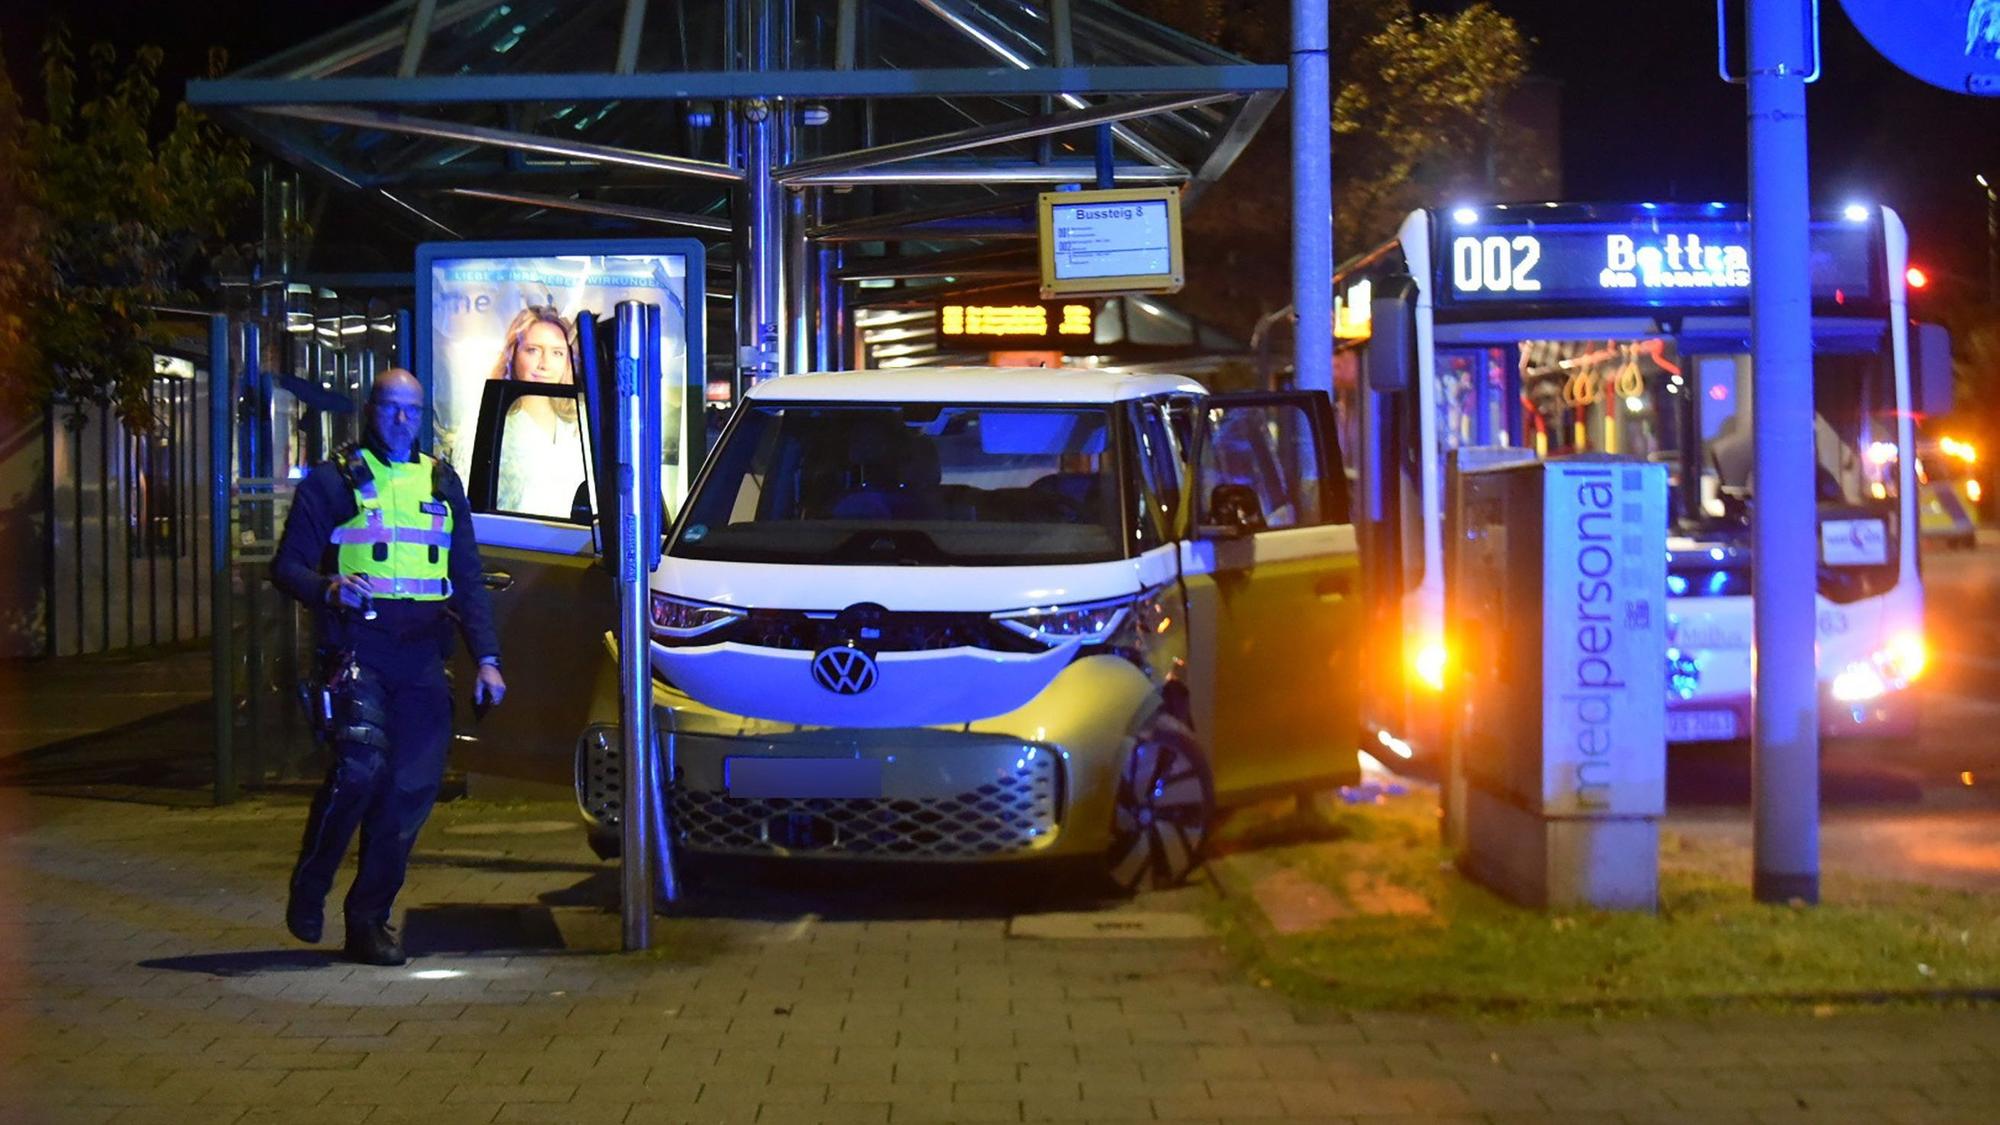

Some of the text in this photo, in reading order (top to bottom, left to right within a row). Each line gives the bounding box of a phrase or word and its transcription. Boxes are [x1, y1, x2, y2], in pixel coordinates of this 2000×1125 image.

[1076, 206, 1144, 221] Bussteig 8
[1453, 236, 1541, 291] 002
[1563, 468, 1625, 809] medpersonal
[813, 647, 877, 693] VW
